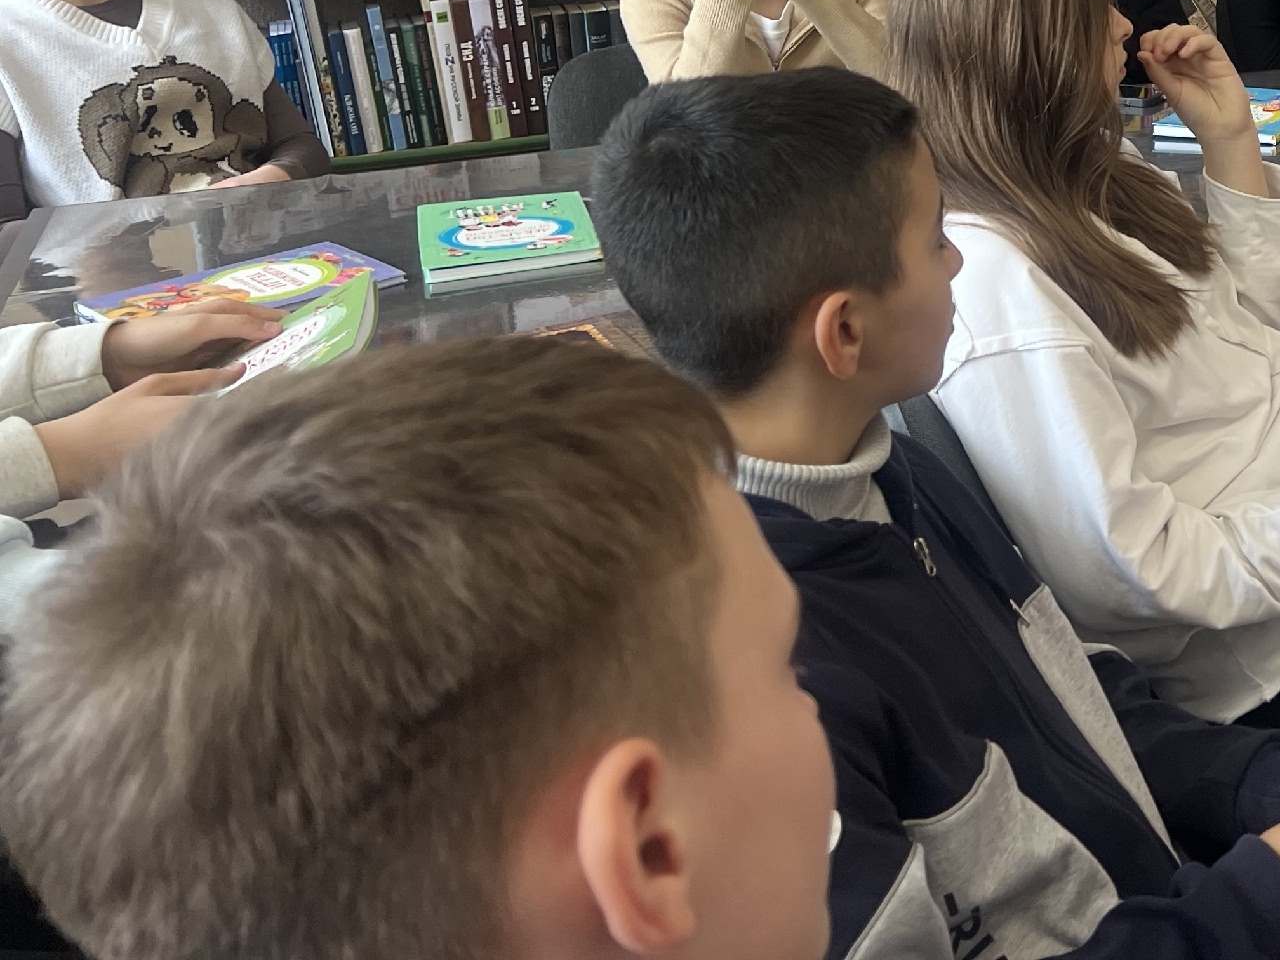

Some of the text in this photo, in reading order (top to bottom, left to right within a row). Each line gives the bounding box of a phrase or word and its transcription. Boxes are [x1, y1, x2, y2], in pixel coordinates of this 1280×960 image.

[497, 8, 507, 29] ПОСЛЕ
[517, 5, 526, 26] ПОСЛЕ
[460, 41, 474, 61] СИД
[450, 75, 462, 121] РУССКОЙ ЗИМЫ
